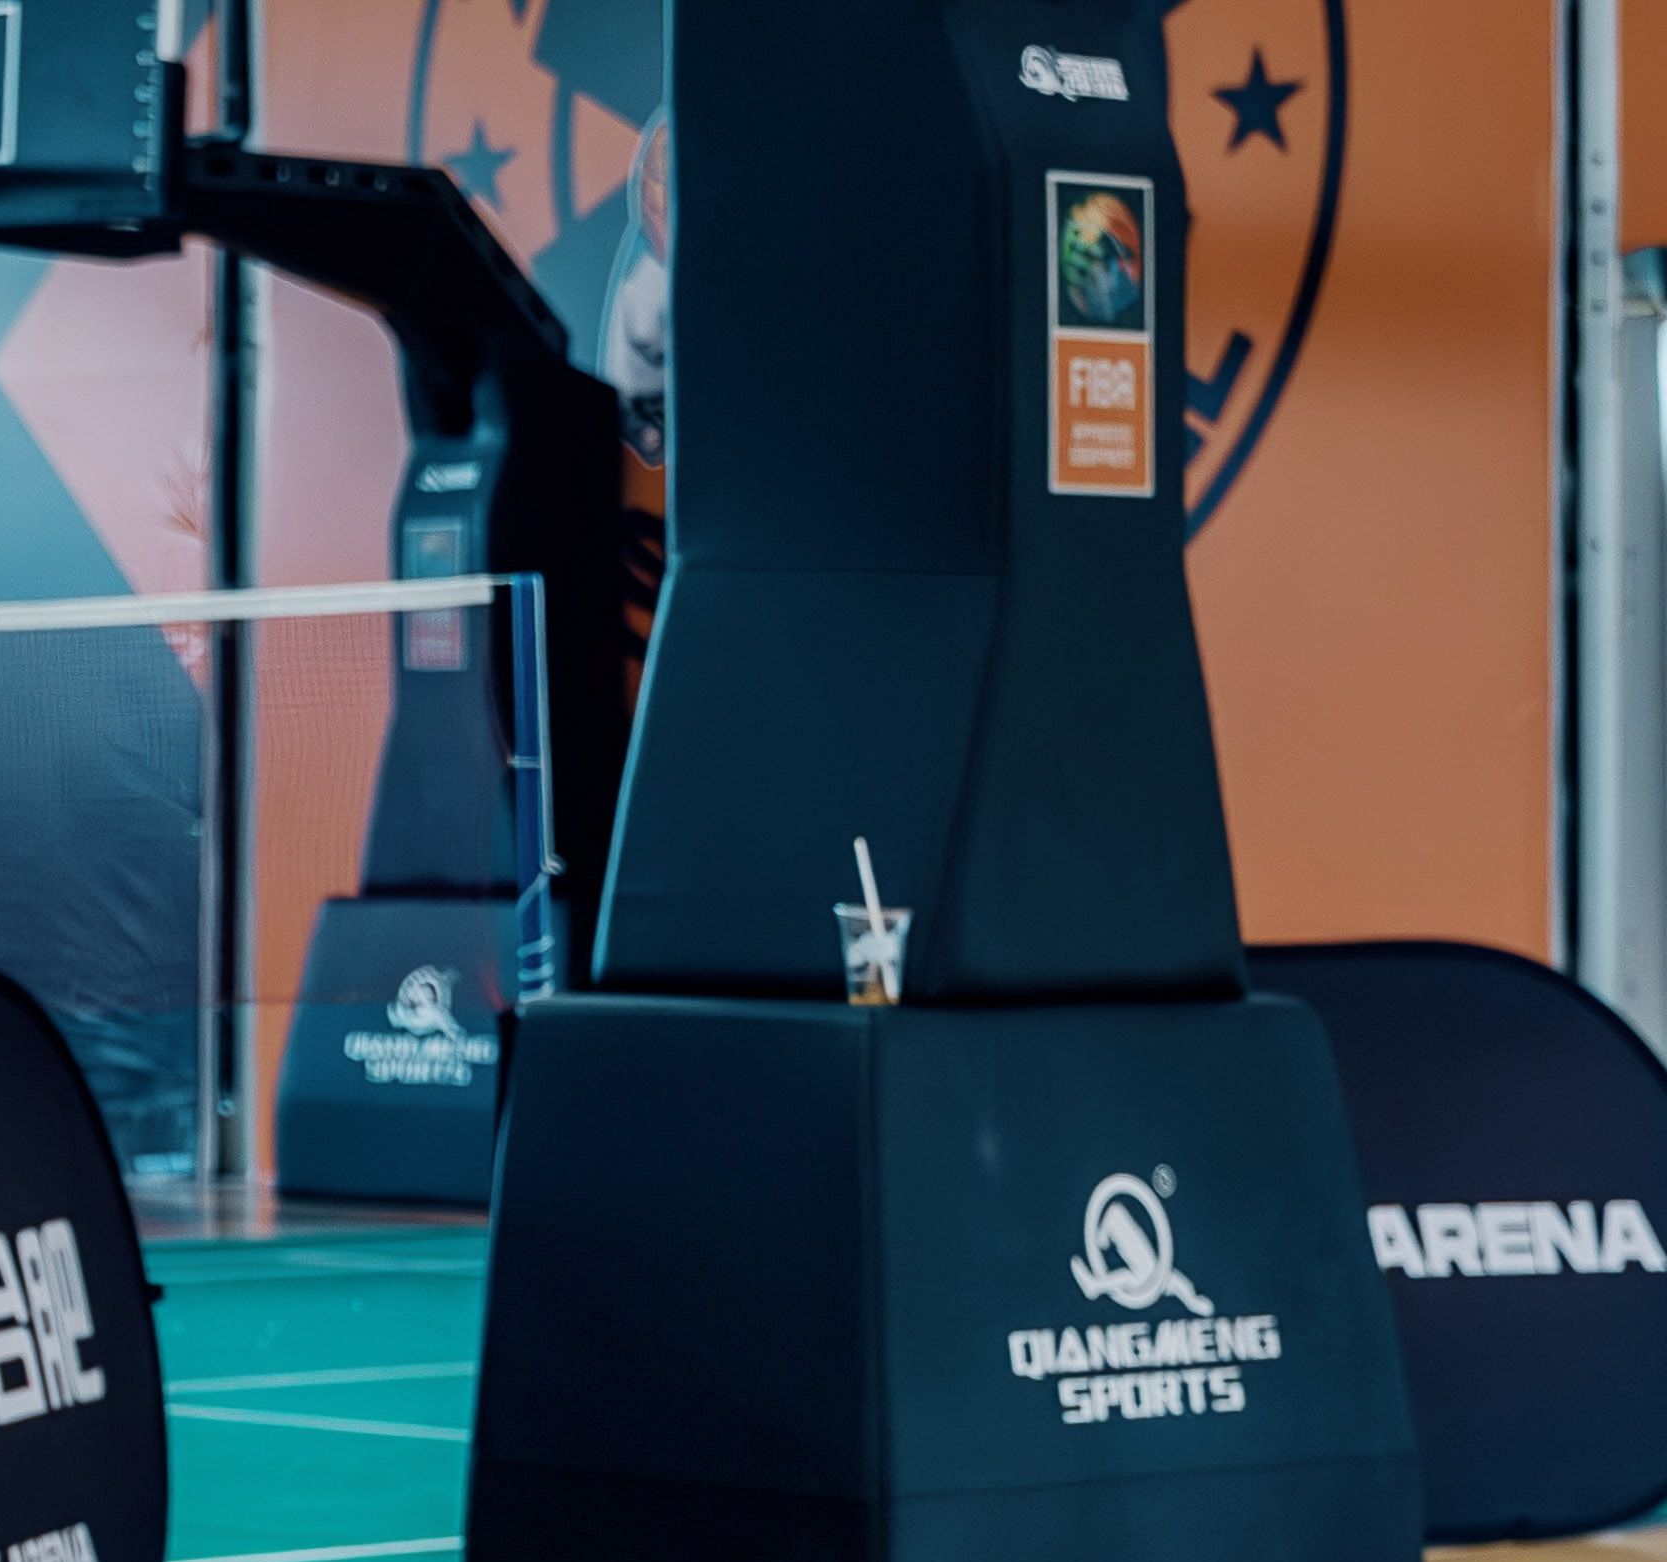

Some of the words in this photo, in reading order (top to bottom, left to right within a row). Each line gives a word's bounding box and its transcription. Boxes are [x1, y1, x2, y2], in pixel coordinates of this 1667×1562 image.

[1068, 357, 1136, 411] FIBA
[1367, 1199, 1667, 1278] ARENA
[1008, 1314, 1282, 1380] QIANGMENG
[1057, 1365, 1246, 1425] SPORTS
